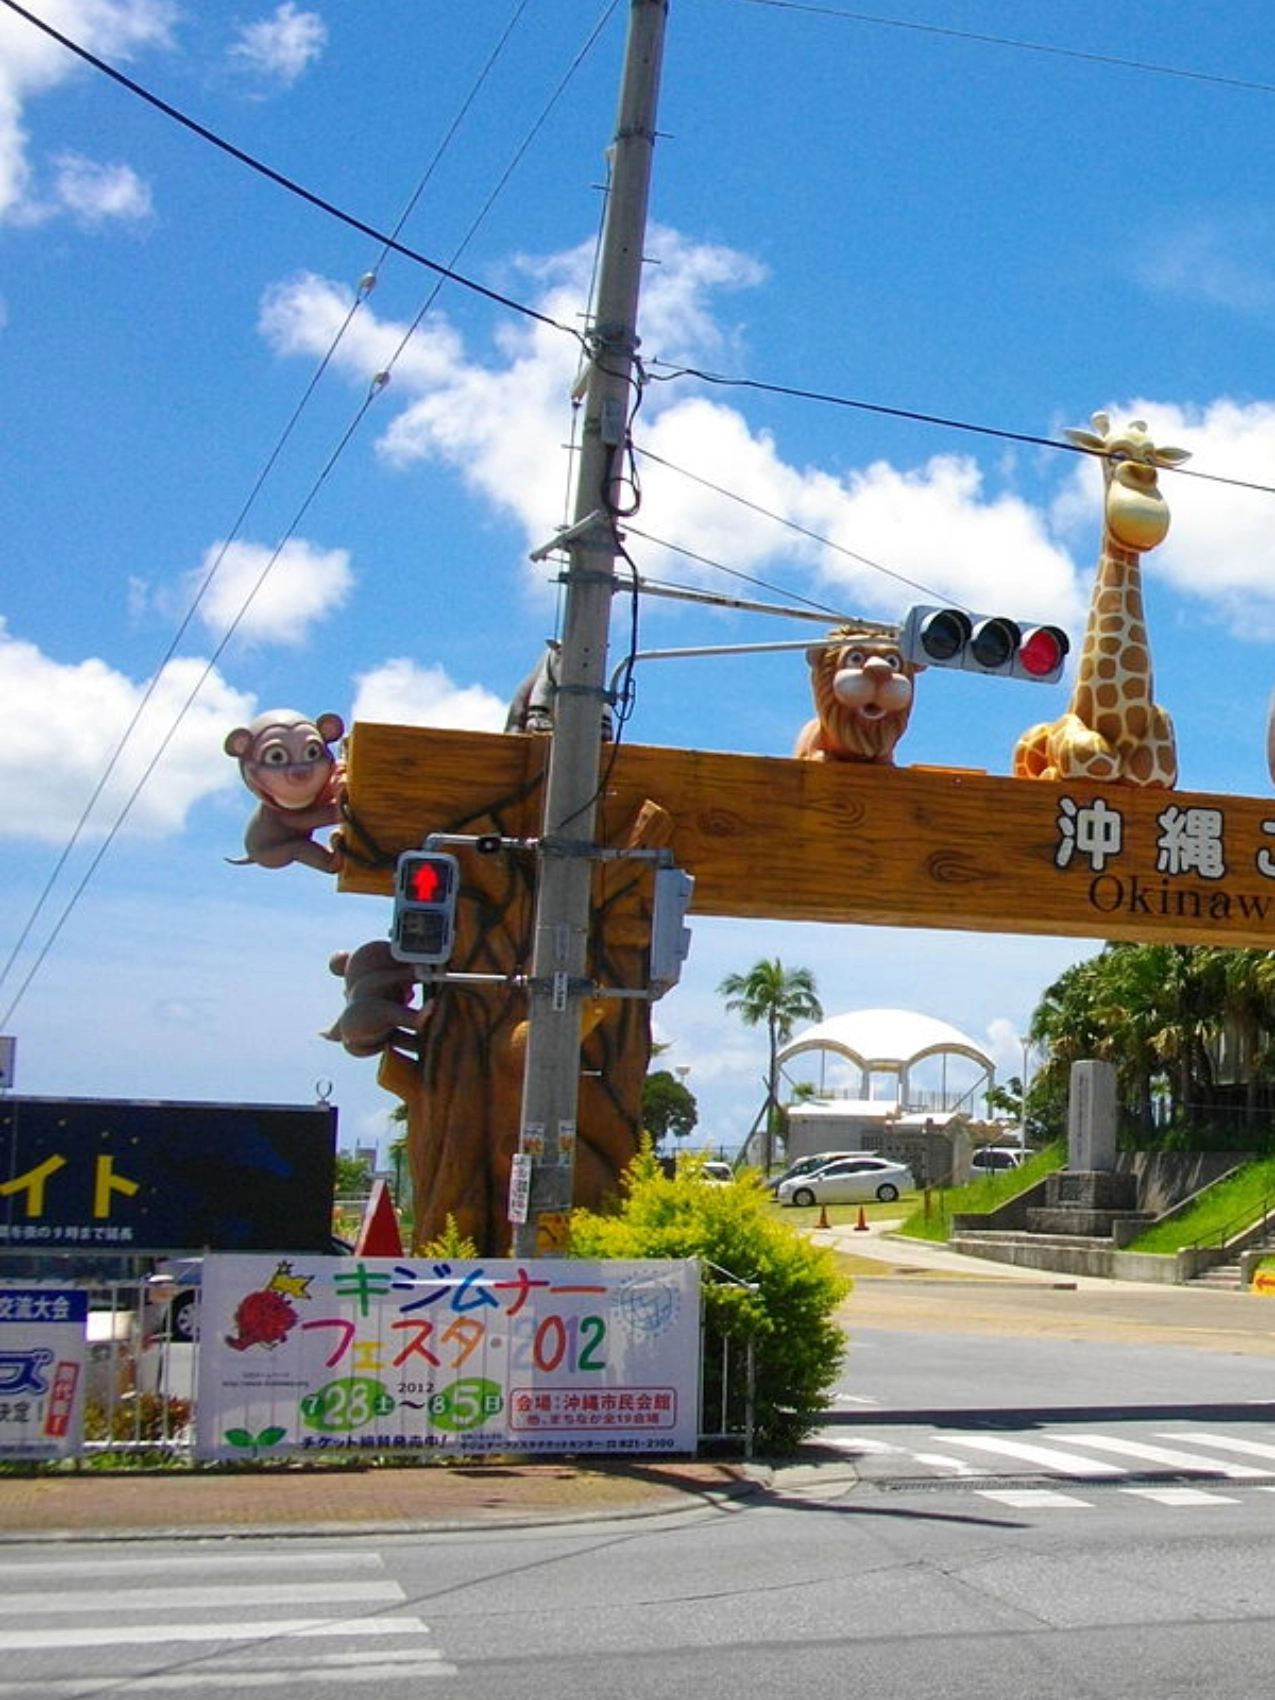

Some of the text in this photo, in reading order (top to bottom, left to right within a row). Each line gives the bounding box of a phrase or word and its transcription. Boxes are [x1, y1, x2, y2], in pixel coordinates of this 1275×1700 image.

[333, 1263, 608, 1317] キジムナー
[398, 1382, 435, 1394] 2012
